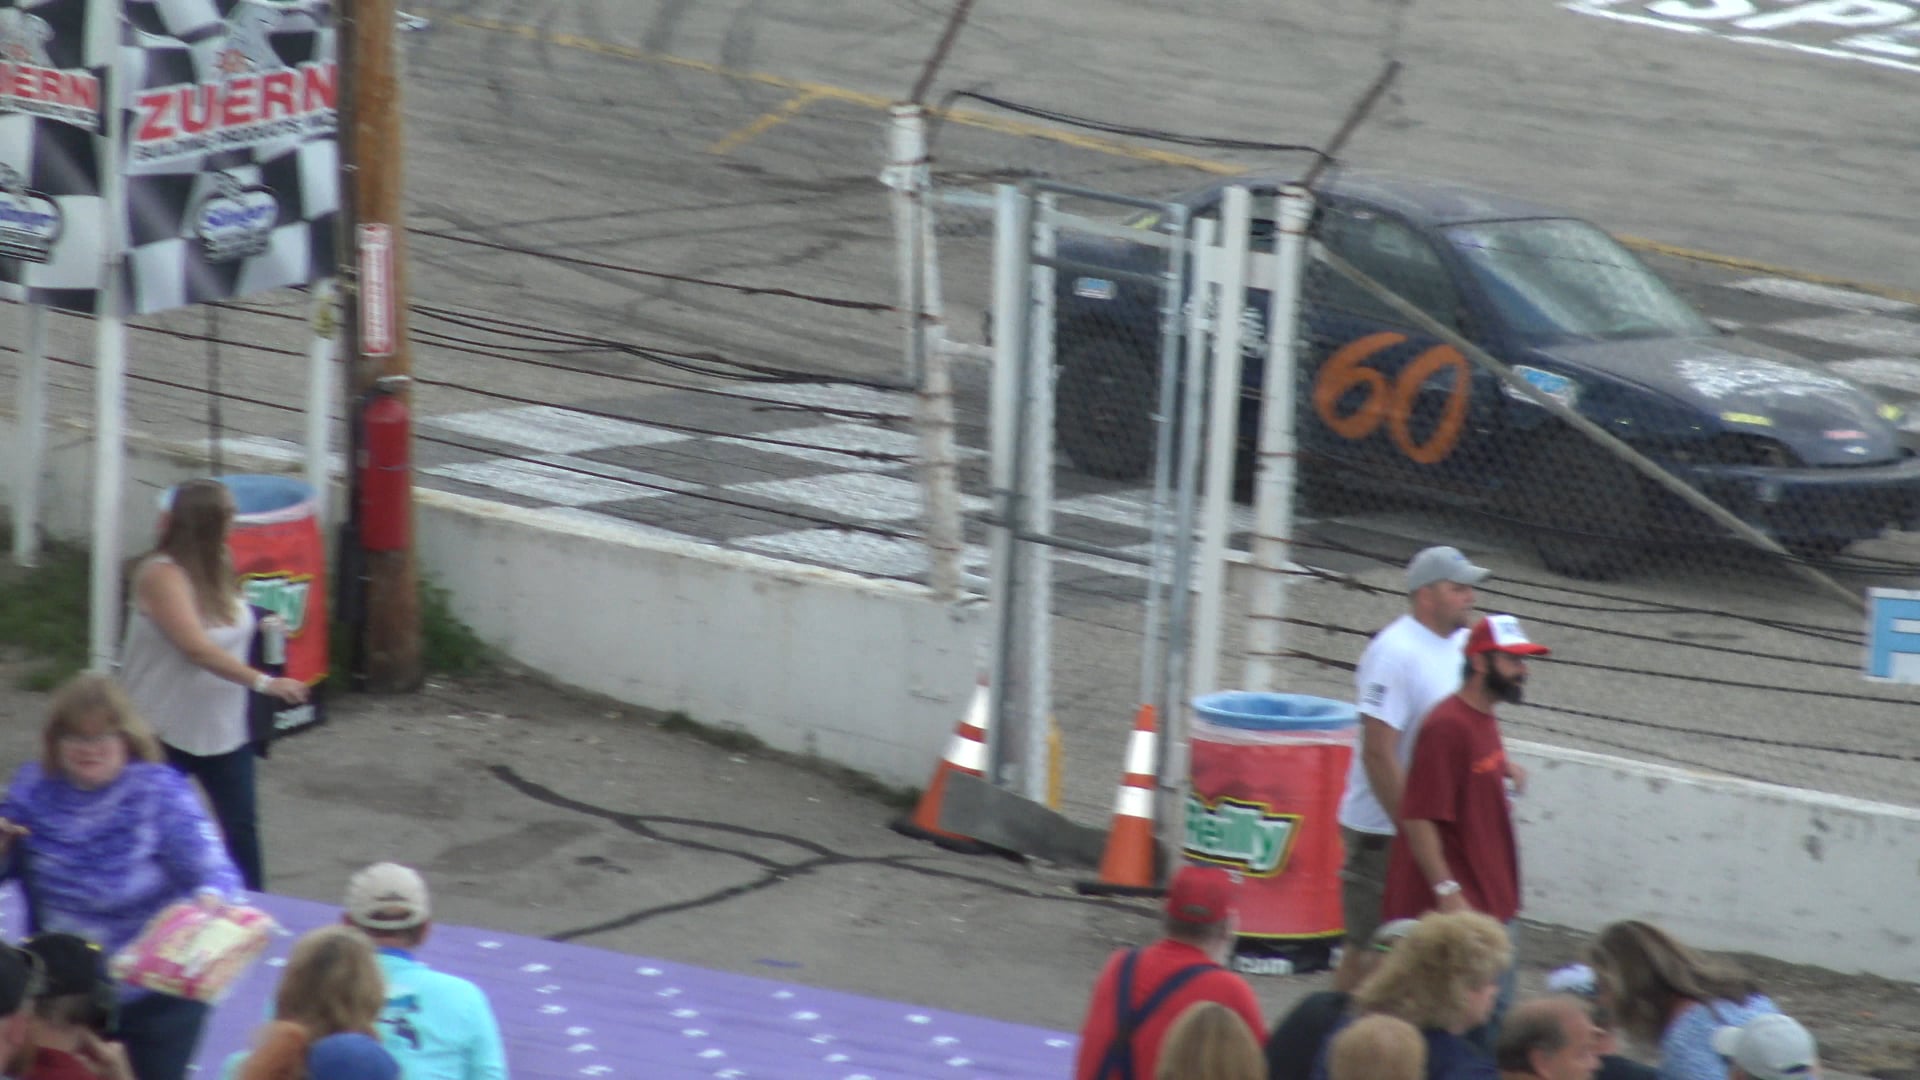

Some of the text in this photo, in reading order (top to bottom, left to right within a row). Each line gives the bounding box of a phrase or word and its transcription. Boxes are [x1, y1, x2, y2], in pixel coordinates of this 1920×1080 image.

[0, 61, 98, 111] ERN
[135, 62, 338, 142] ZUERN
[1314, 331, 1470, 464] 60
